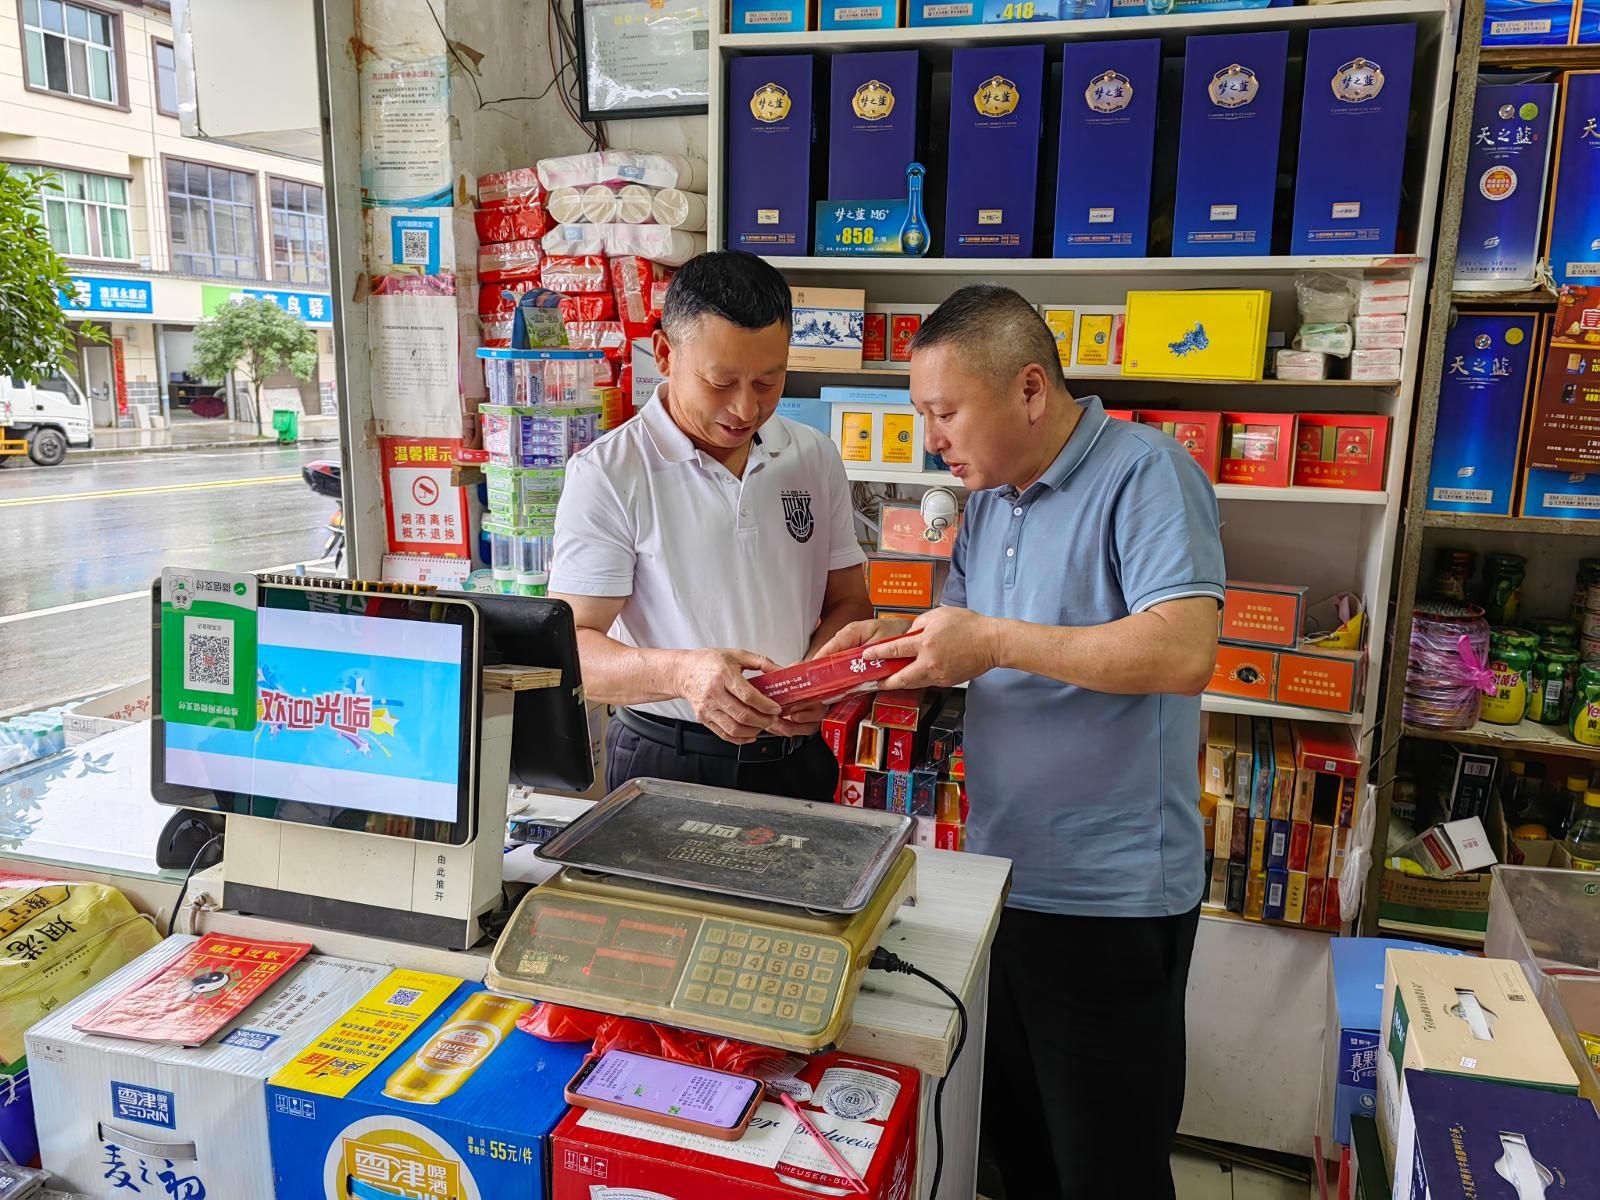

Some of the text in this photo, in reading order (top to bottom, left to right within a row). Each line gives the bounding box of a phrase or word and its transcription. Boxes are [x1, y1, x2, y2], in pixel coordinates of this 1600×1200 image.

[1003, 2, 1033, 19] 418
[1218, 81, 1249, 94] 梦之蓝
[1341, 75, 1374, 89] 梦之蓝
[983, 92, 1011, 105] 梦之蓝
[1094, 86, 1124, 99] 梦之蓝
[758, 98, 784, 110] 梦之蓝
[861, 95, 887, 108] 梦之蓝
[835, 208, 865, 223] 梦之蓝
[394, 446, 451, 462] 温馨提示
[401, 513, 455, 526] 烟酒离柜
[403, 528, 455, 540] 概不退换
[196, 580, 231, 594] 微信支付
[260, 691, 373, 735] 欢迎光临
[435, 855, 446, 902] 由此推开
[757, 938, 766, 949] 7
[777, 942, 788, 953] 8
[799, 946, 810, 957] 9
[750, 957, 759, 969] 4
[771, 961, 783, 973] 5
[794, 965, 804, 977] 6
[745, 976, 753, 987] 1
[764, 980, 776, 993] 2
[787, 985, 799, 997] 3
[782, 1004, 793, 1016] 0
[120, 1104, 169, 1123] SEDRIN
[490, 1140, 533, 1165] 55元/件
